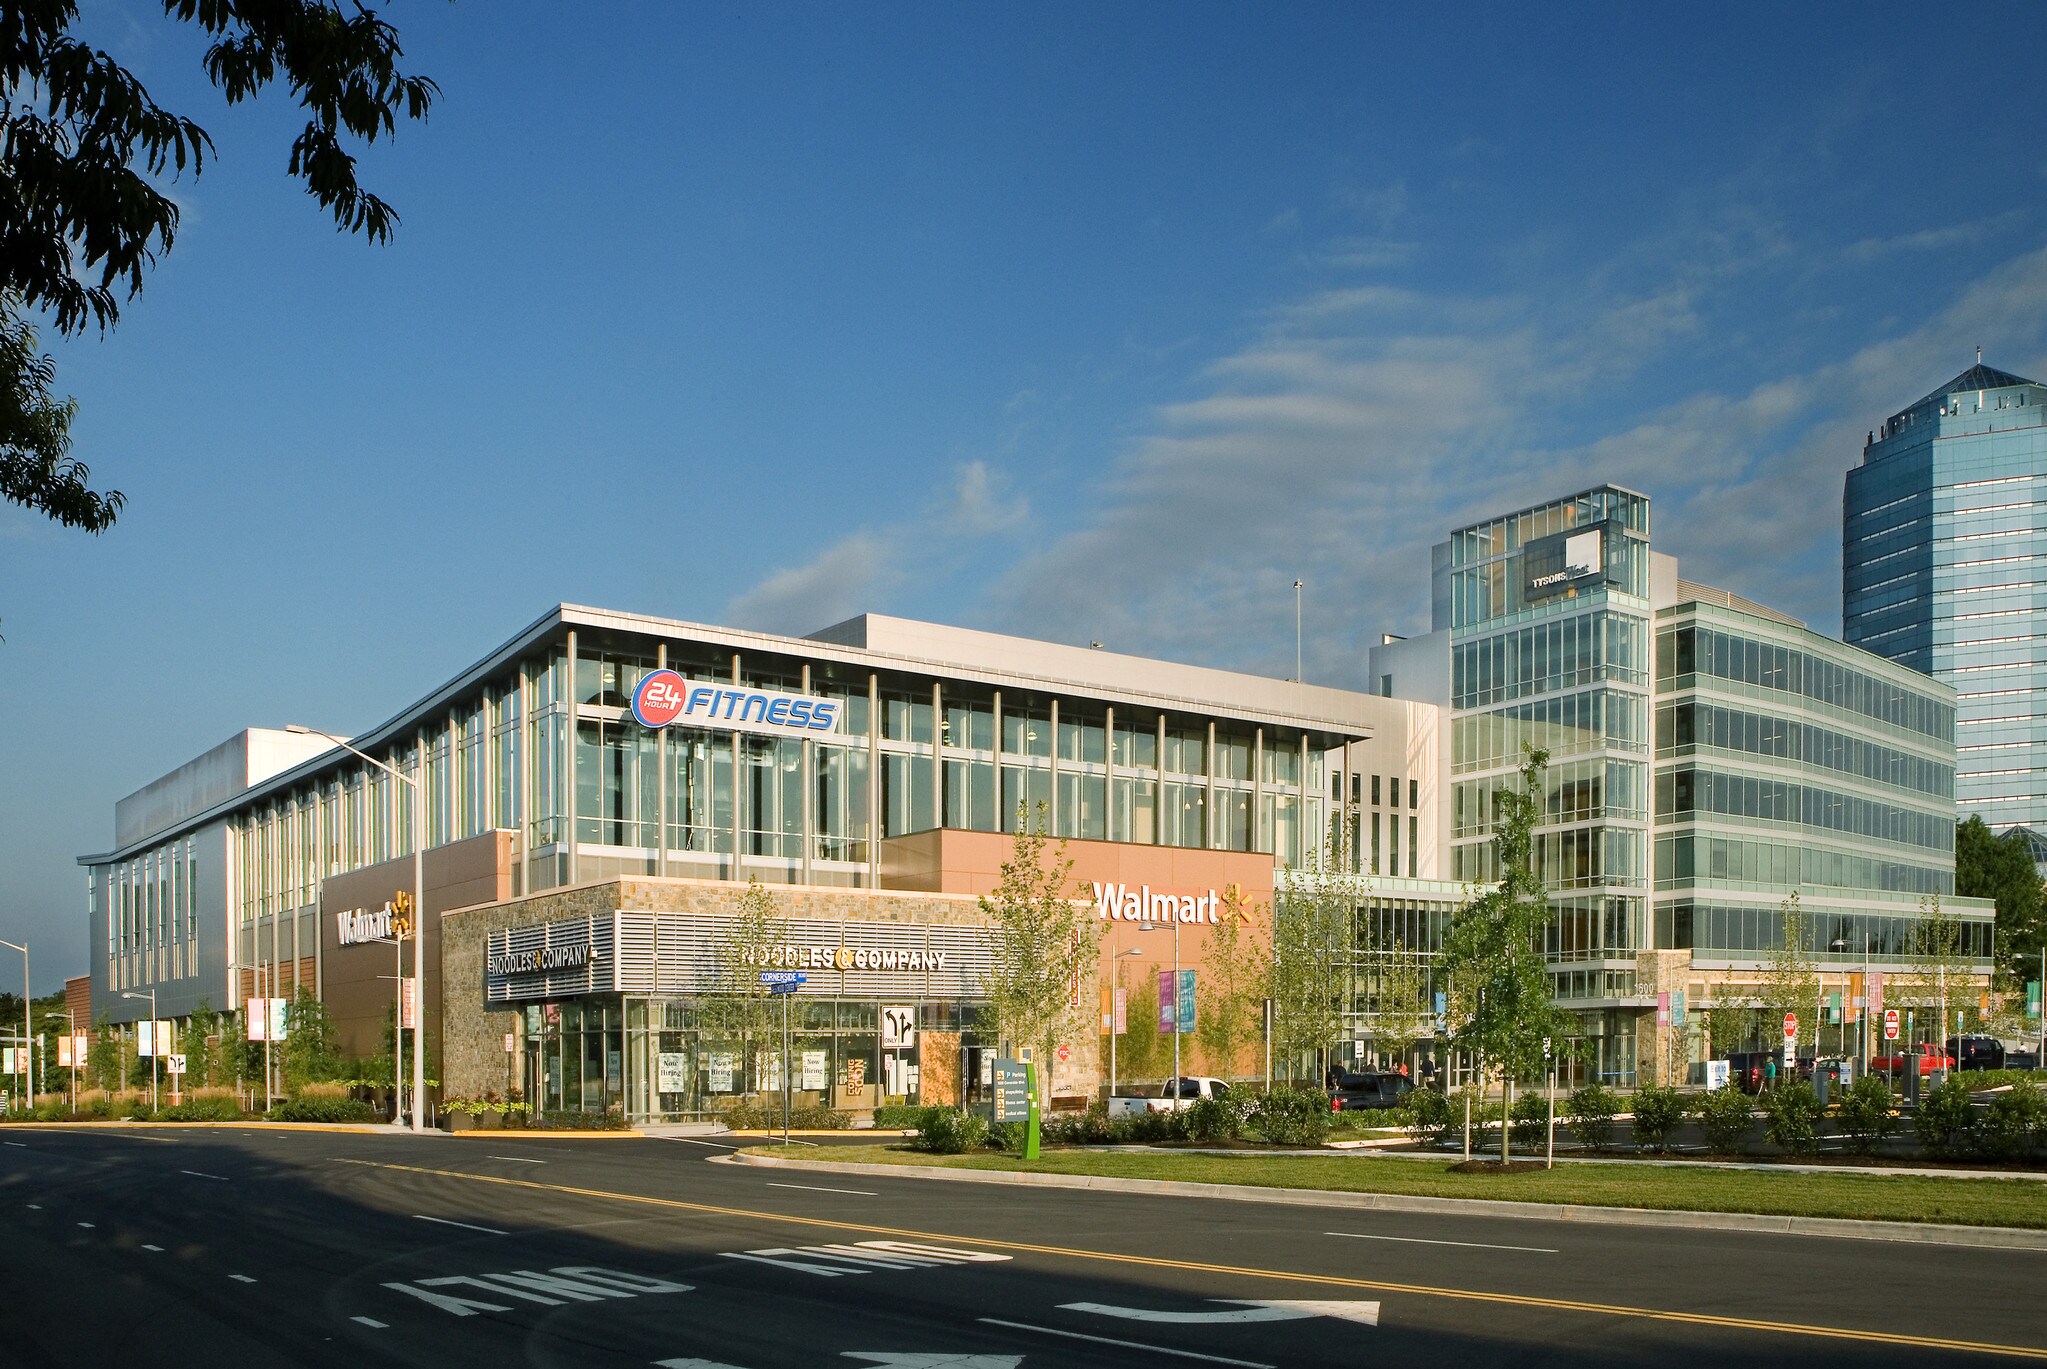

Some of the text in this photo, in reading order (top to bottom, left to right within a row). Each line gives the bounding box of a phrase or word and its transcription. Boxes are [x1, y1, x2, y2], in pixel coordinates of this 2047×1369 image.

[1532, 571, 1566, 588] TYSONS
[644, 700, 670, 710] HOUR
[646, 682, 682, 711] 24
[684, 688, 838, 731] FITNESS
[1092, 881, 1220, 924] Walmart
[336, 900, 393, 945] Walmart
[492, 952, 534, 974] NOODLES
[542, 944, 589, 969] COMPANY
[741, 946, 834, 968] NOODLES
[854, 949, 946, 970] COMPANY
[761, 972, 797, 982] CORNERSIDE
[1784, 1020, 1796, 1030] STOP
[660, 1069, 682, 1077] Hiring
[711, 1069, 731, 1077] Hiring
[804, 1067, 823, 1075] Hiring
[855, 1059, 864, 1095] SOON
[717, 1240, 1013, 1277] ONLY
[379, 1266, 696, 1316] ONLY
